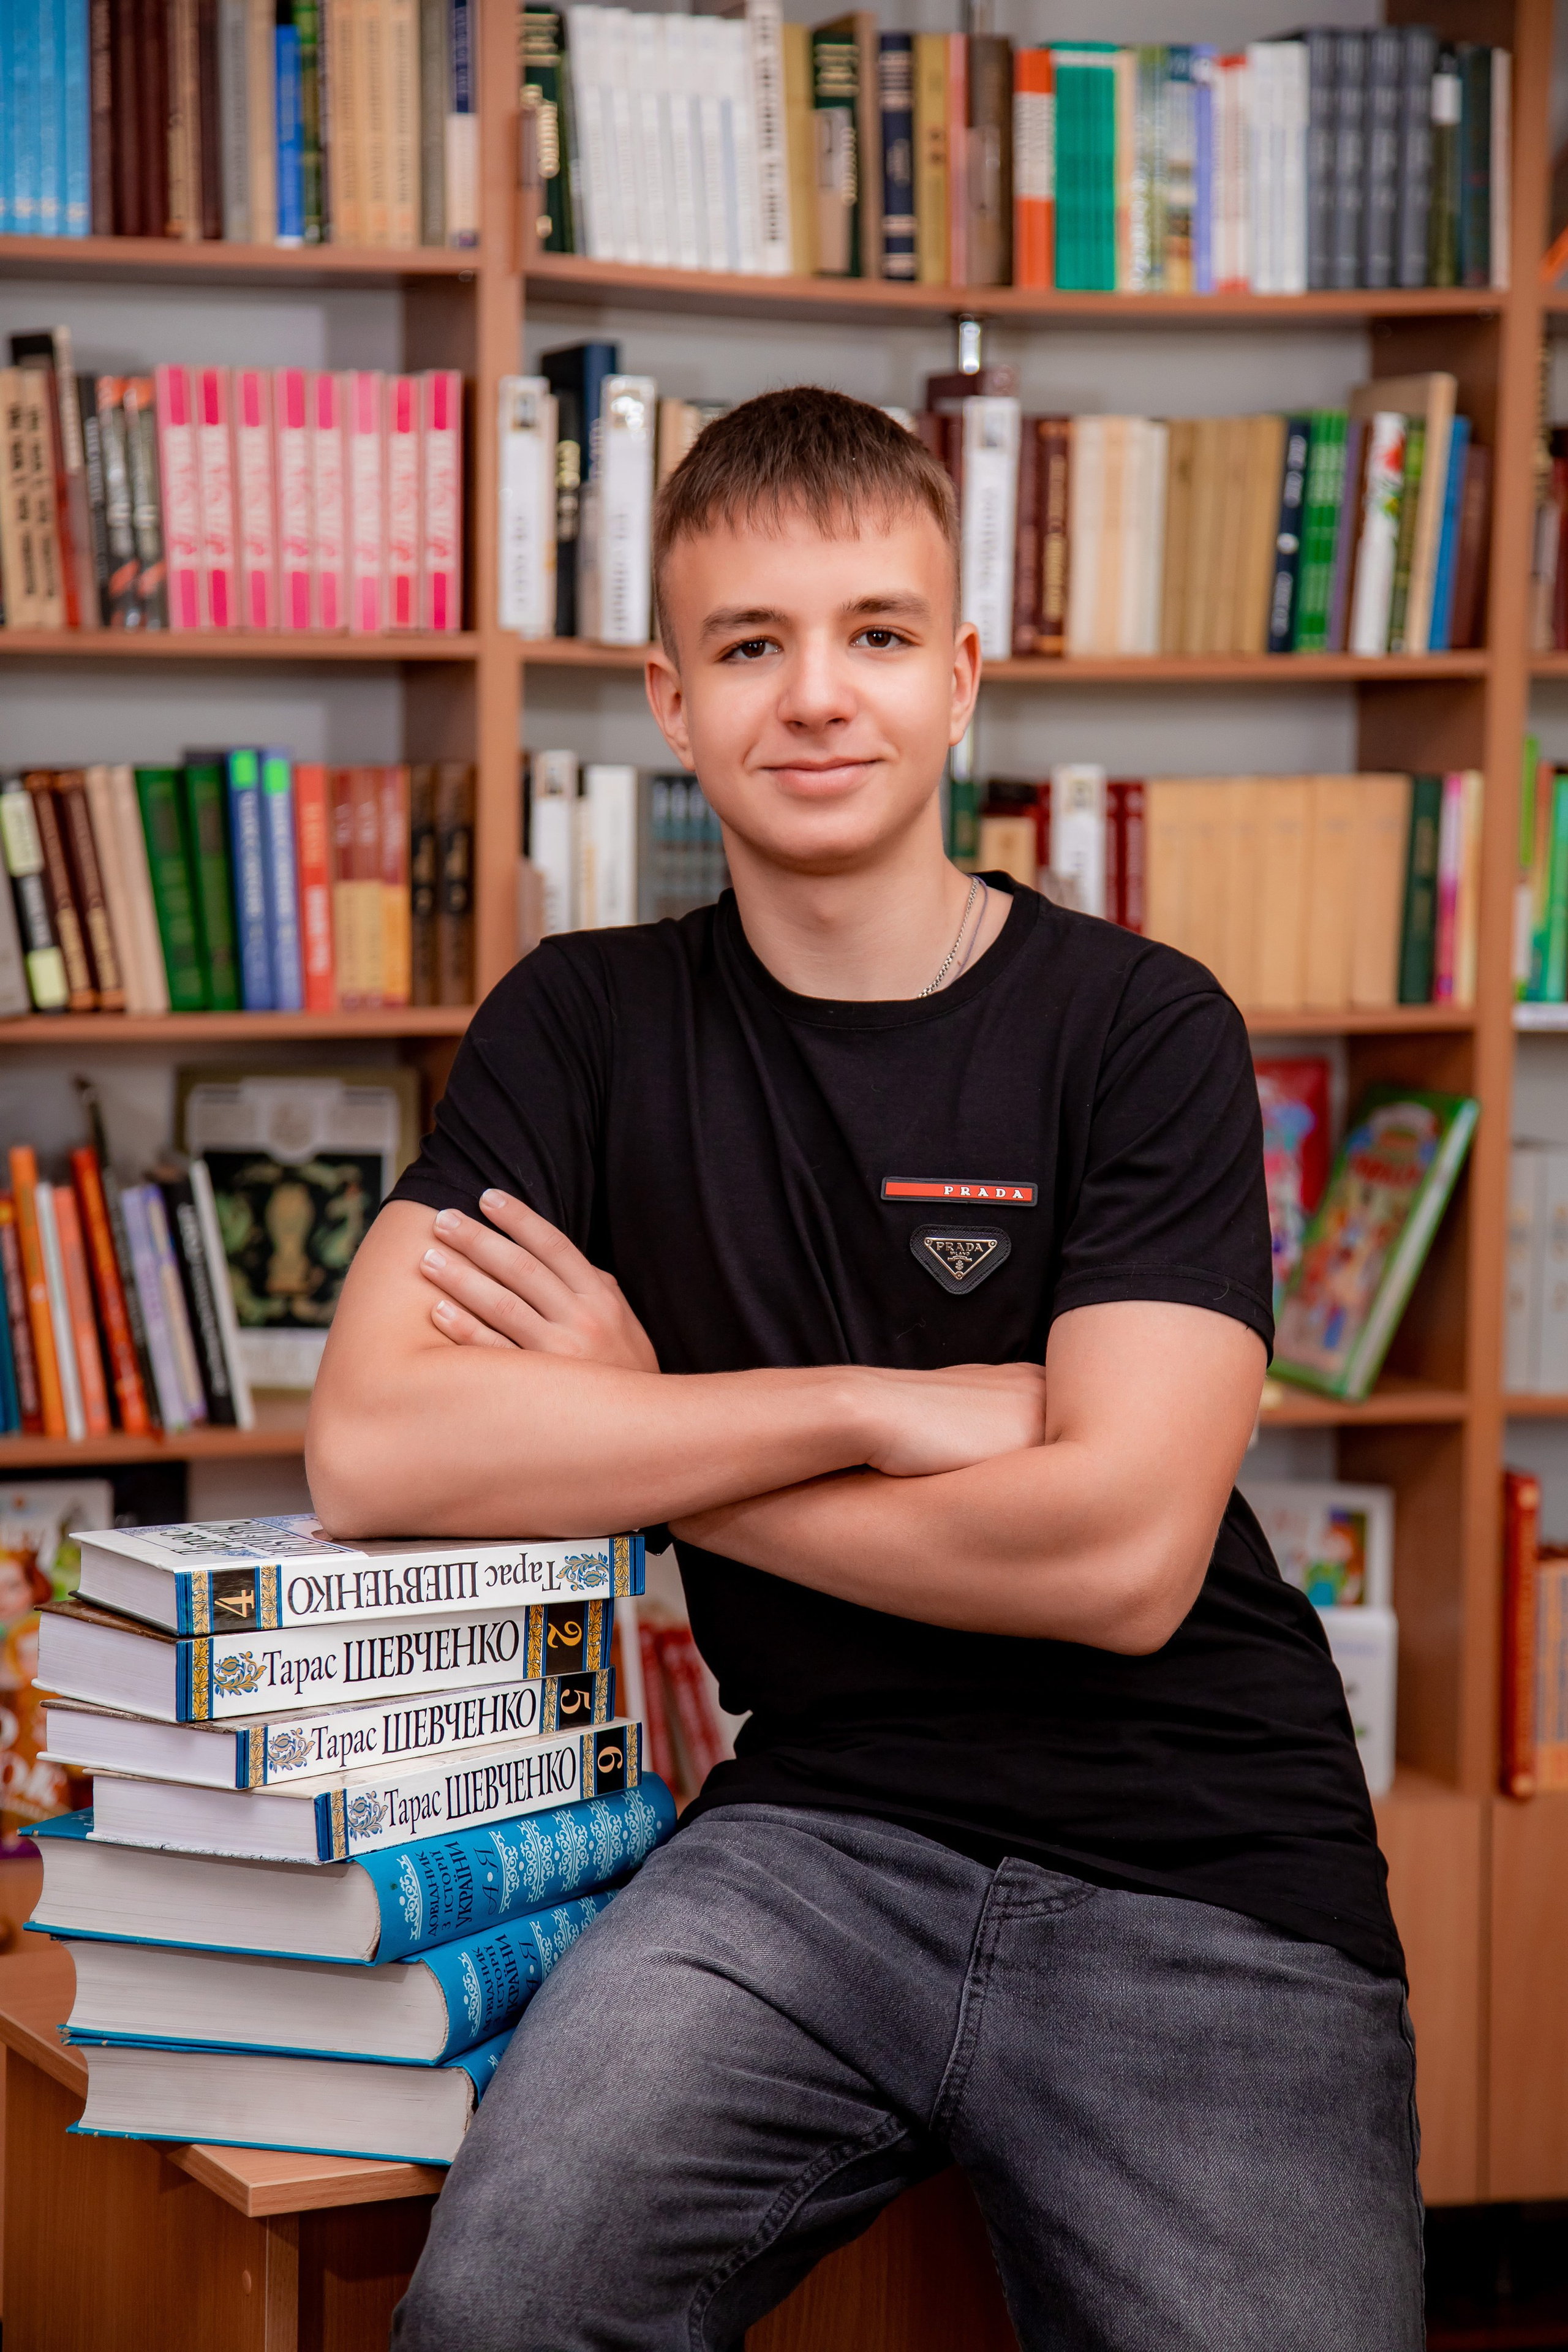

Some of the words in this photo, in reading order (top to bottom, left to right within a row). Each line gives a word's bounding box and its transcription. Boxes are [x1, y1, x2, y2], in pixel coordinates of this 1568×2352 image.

[943, 1186, 1023, 1199] PRADA
[936, 1242, 984, 1252] PRADA
[287, 1562, 478, 1615] ШЕВЧЕНКО
[486, 1553, 562, 1592] Тарас
[214, 1589, 255, 1618] 4
[262, 1649, 337, 1695] Тарас
[342, 1620, 520, 1684] ШЕВЧЕНКО
[548, 1621, 583, 1648] 2
[311, 1725, 377, 1767] Тарас
[382, 1688, 537, 1755] ШЕВЧЕНКО
[560, 1689, 591, 1714] 5
[597, 1746, 624, 1774] 6
[383, 1789, 442, 1834] Тарас
[445, 1746, 577, 1821] ШЕВЧЕНКО
[414, 1850, 440, 1937] ДОВІДНИК
[429, 1850, 454, 1914] ІСТОРІЇ
[443, 1841, 473, 1929] УКРАЇНИ
[483, 1944, 505, 2009] ІСТОРІЇ
